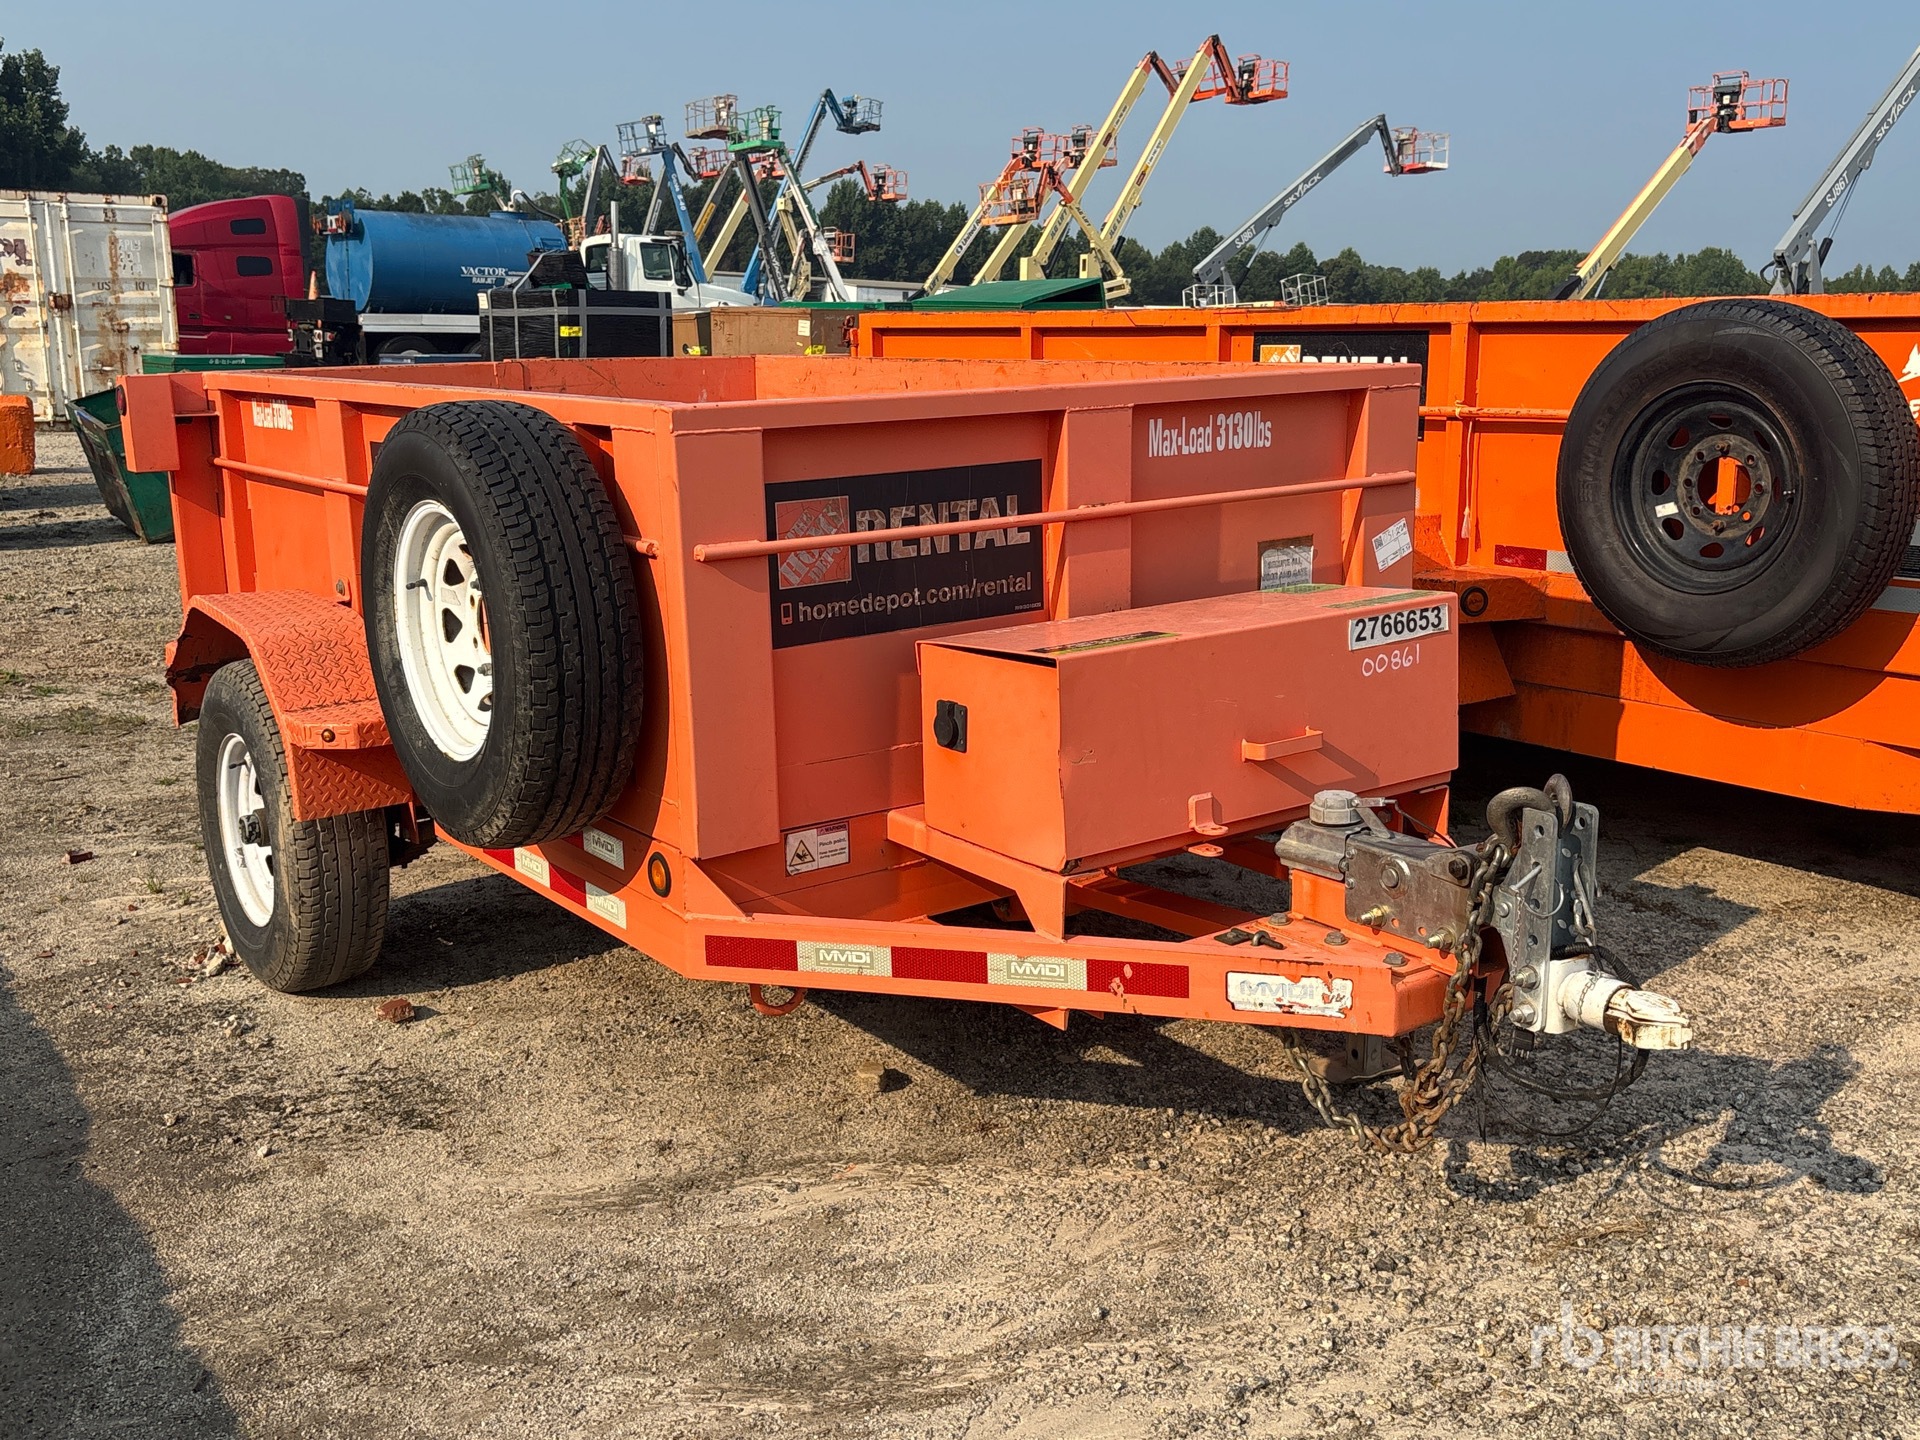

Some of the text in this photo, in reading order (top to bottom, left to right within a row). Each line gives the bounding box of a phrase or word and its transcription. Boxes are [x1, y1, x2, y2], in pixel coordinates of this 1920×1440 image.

[1875, 85, 1916, 142] SKYJACK
[1283, 172, 1321, 208] SKYJACK
[1825, 170, 1849, 207] SJ86T
[1057, 208, 1068, 227] LIFT
[1116, 206, 1128, 223] LIFT
[961, 222, 978, 247] United
[1234, 224, 1257, 249] SJ86T
[461, 266, 506, 277] VACTOR
[1148, 410, 1272, 458] Max-Load 3130lbs
[855, 494, 1031, 564] RENTAL
[798, 571, 1032, 623] homedepot.com/rental
[1354, 605, 1442, 643] 2766653
[1361, 643, 1420, 677] 00861
